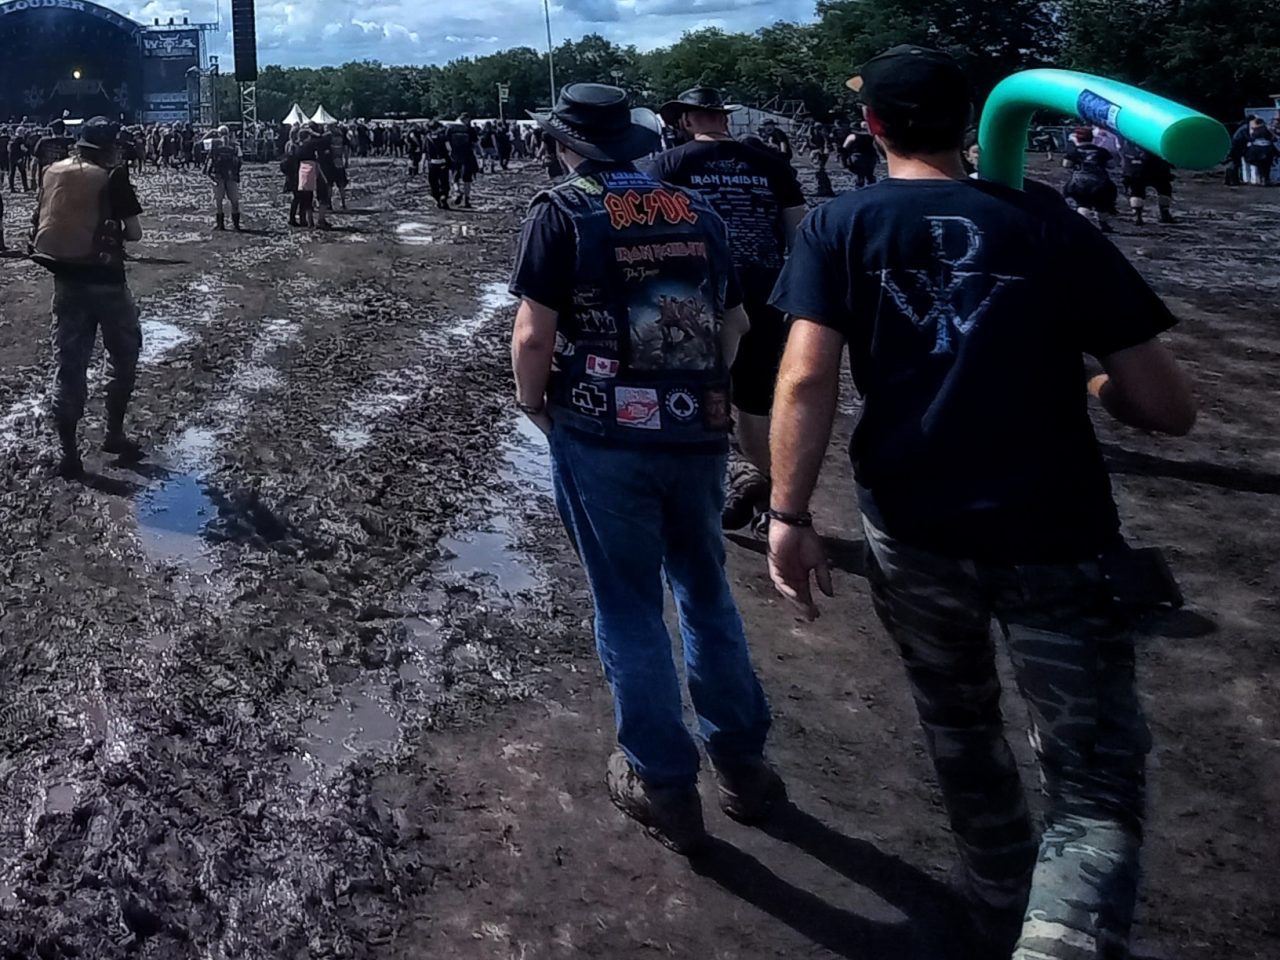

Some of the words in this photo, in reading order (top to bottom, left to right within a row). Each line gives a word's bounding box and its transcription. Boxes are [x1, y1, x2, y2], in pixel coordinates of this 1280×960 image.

[689, 174, 721, 186] IRON
[721, 174, 769, 188] MAIDEN
[614, 244, 653, 265] IRON
